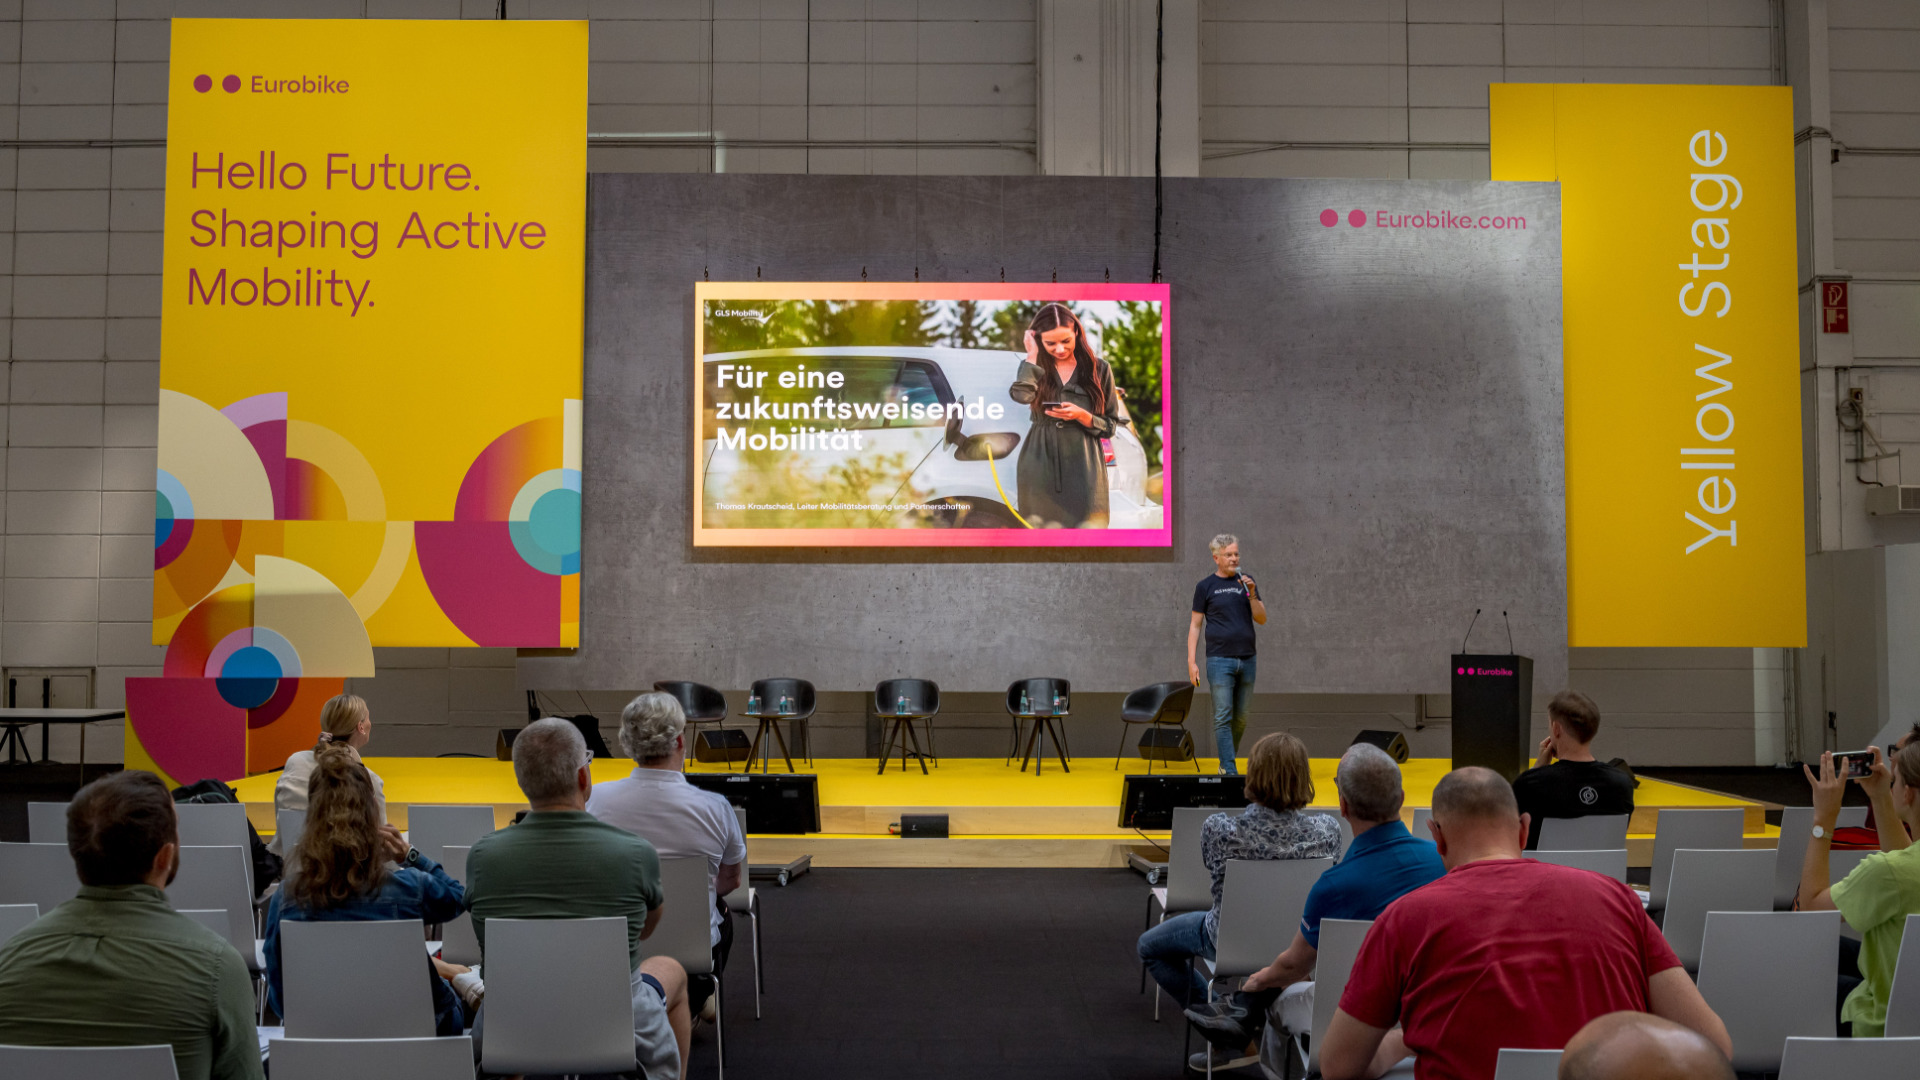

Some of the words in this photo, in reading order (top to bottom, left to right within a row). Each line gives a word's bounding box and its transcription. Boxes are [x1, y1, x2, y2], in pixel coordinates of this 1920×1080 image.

[250, 75, 350, 94] Eurobike
[191, 151, 308, 190] Hello
[326, 152, 480, 191] Future.
[1375, 210, 1527, 230] Eurobike.com
[1679, 129, 1743, 318] Stage
[190, 208, 379, 259] Shaping
[397, 212, 547, 249] Active
[188, 267, 375, 317] Mobility.
[731, 309, 763, 318] Mobility
[716, 365, 769, 388] Für
[778, 364, 845, 388] eine
[716, 396, 1004, 420] zukunftsweisende
[716, 427, 863, 451] Mobilität
[1680, 343, 1738, 554] Yellow
[715, 502, 746, 510] Thomas
[748, 502, 795, 511] Krautscheid,
[797, 502, 818, 510] Leiter
[820, 502, 892, 512] Mobilitätsberatung
[910, 502, 970, 511] Partnerschaften
[1477, 667, 1513, 676] Eurobike
